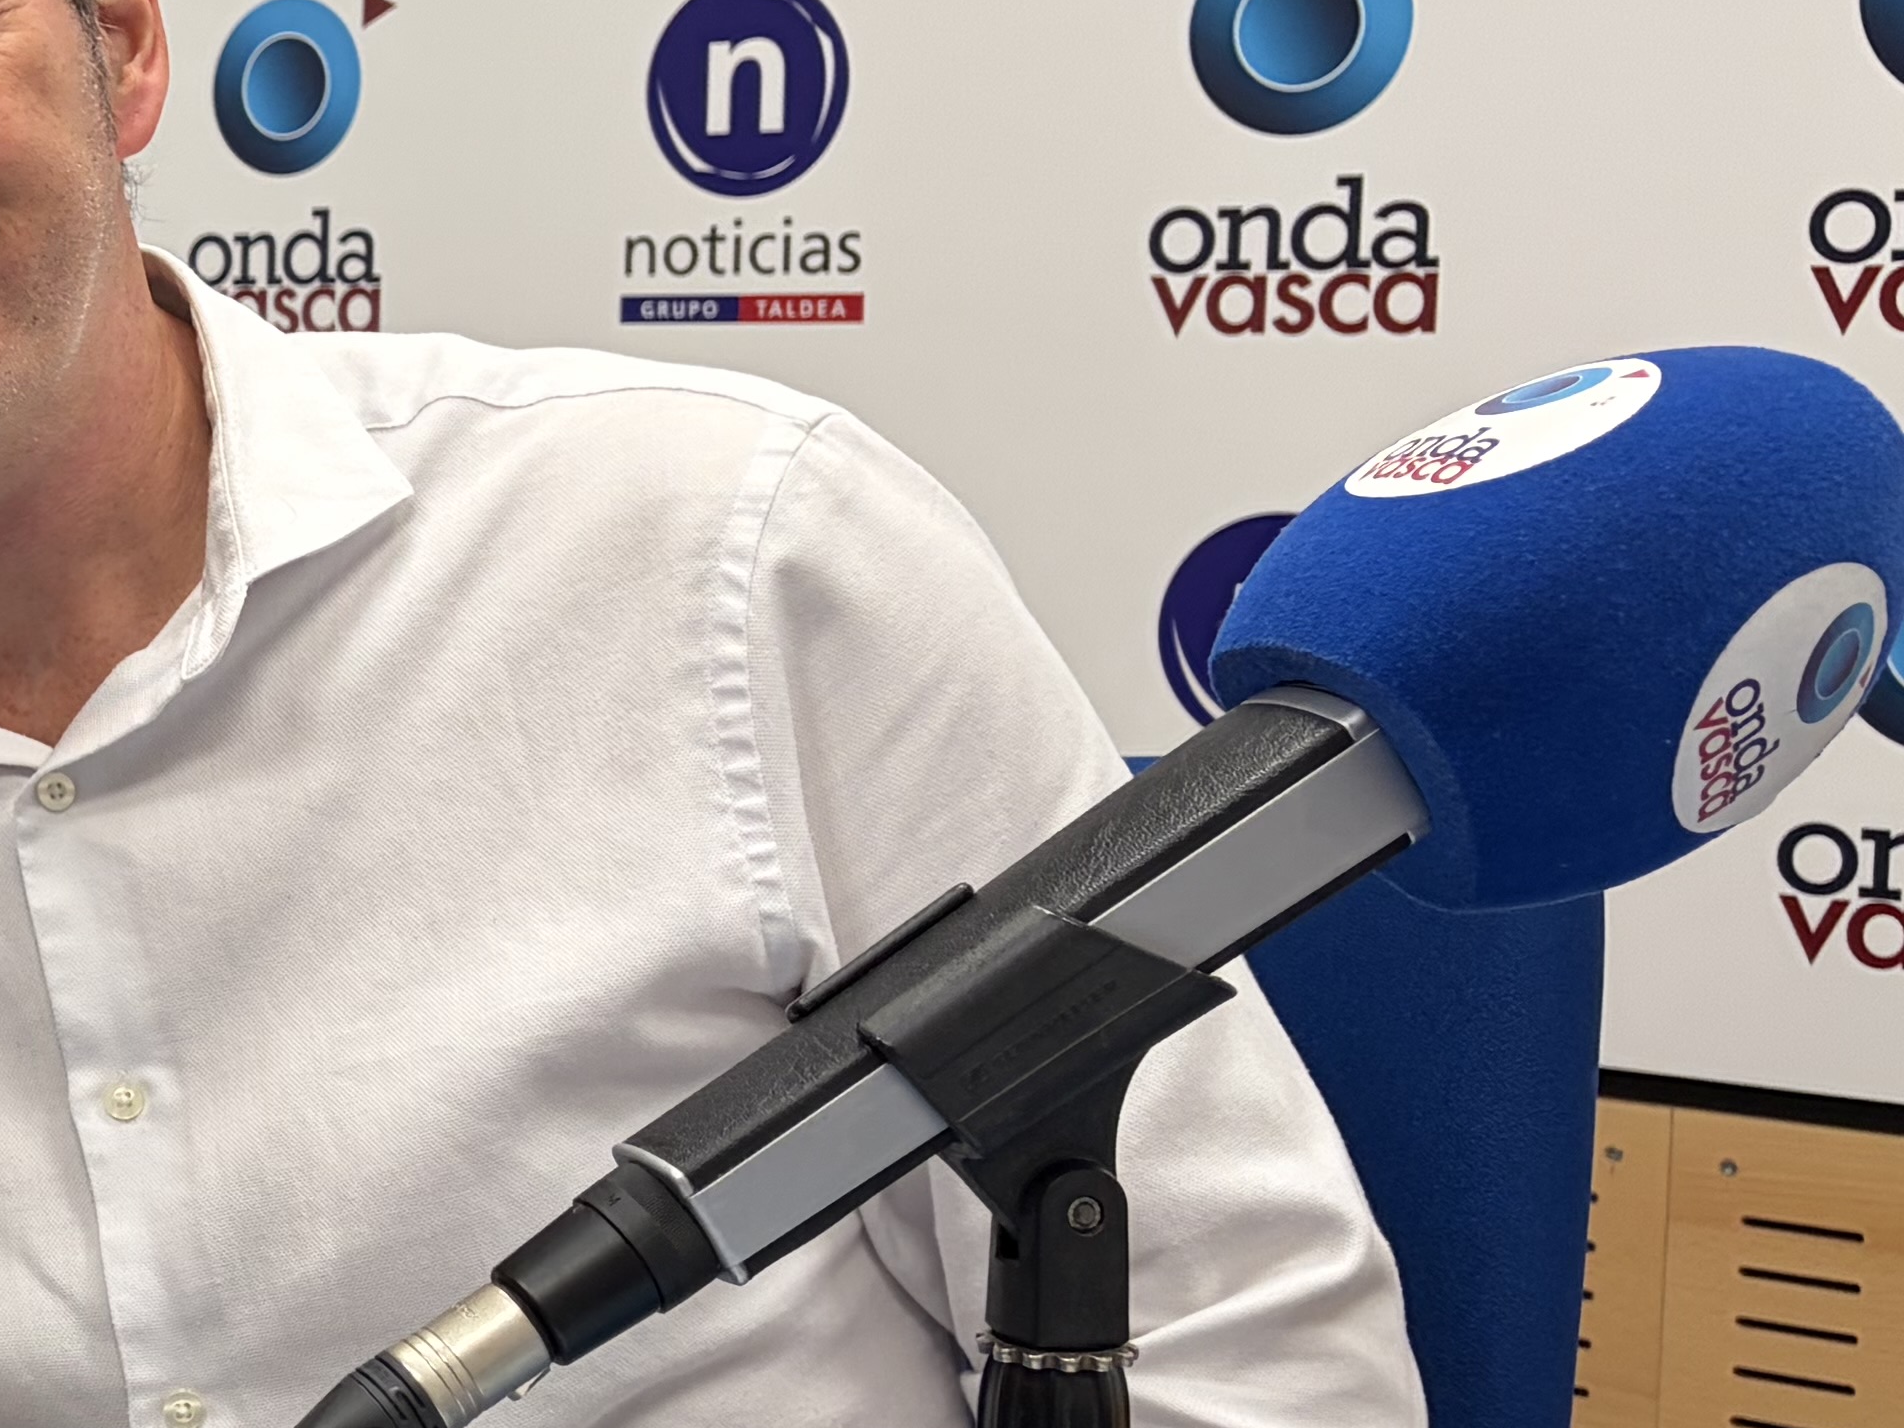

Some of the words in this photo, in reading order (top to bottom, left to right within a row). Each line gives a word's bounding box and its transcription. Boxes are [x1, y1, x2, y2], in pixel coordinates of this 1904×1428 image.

[705, 35, 786, 136] n
[187, 206, 381, 288] onda
[623, 217, 863, 277] noticias
[1147, 174, 1440, 278] onda
[216, 285, 381, 334] asca
[639, 299, 719, 320] GRUPO
[755, 298, 848, 319] TALDEA
[1151, 272, 1441, 337] vasca
[1384, 426, 1500, 463] onda
[1693, 696, 1737, 824] vasca
[1724, 677, 1781, 801] onda
